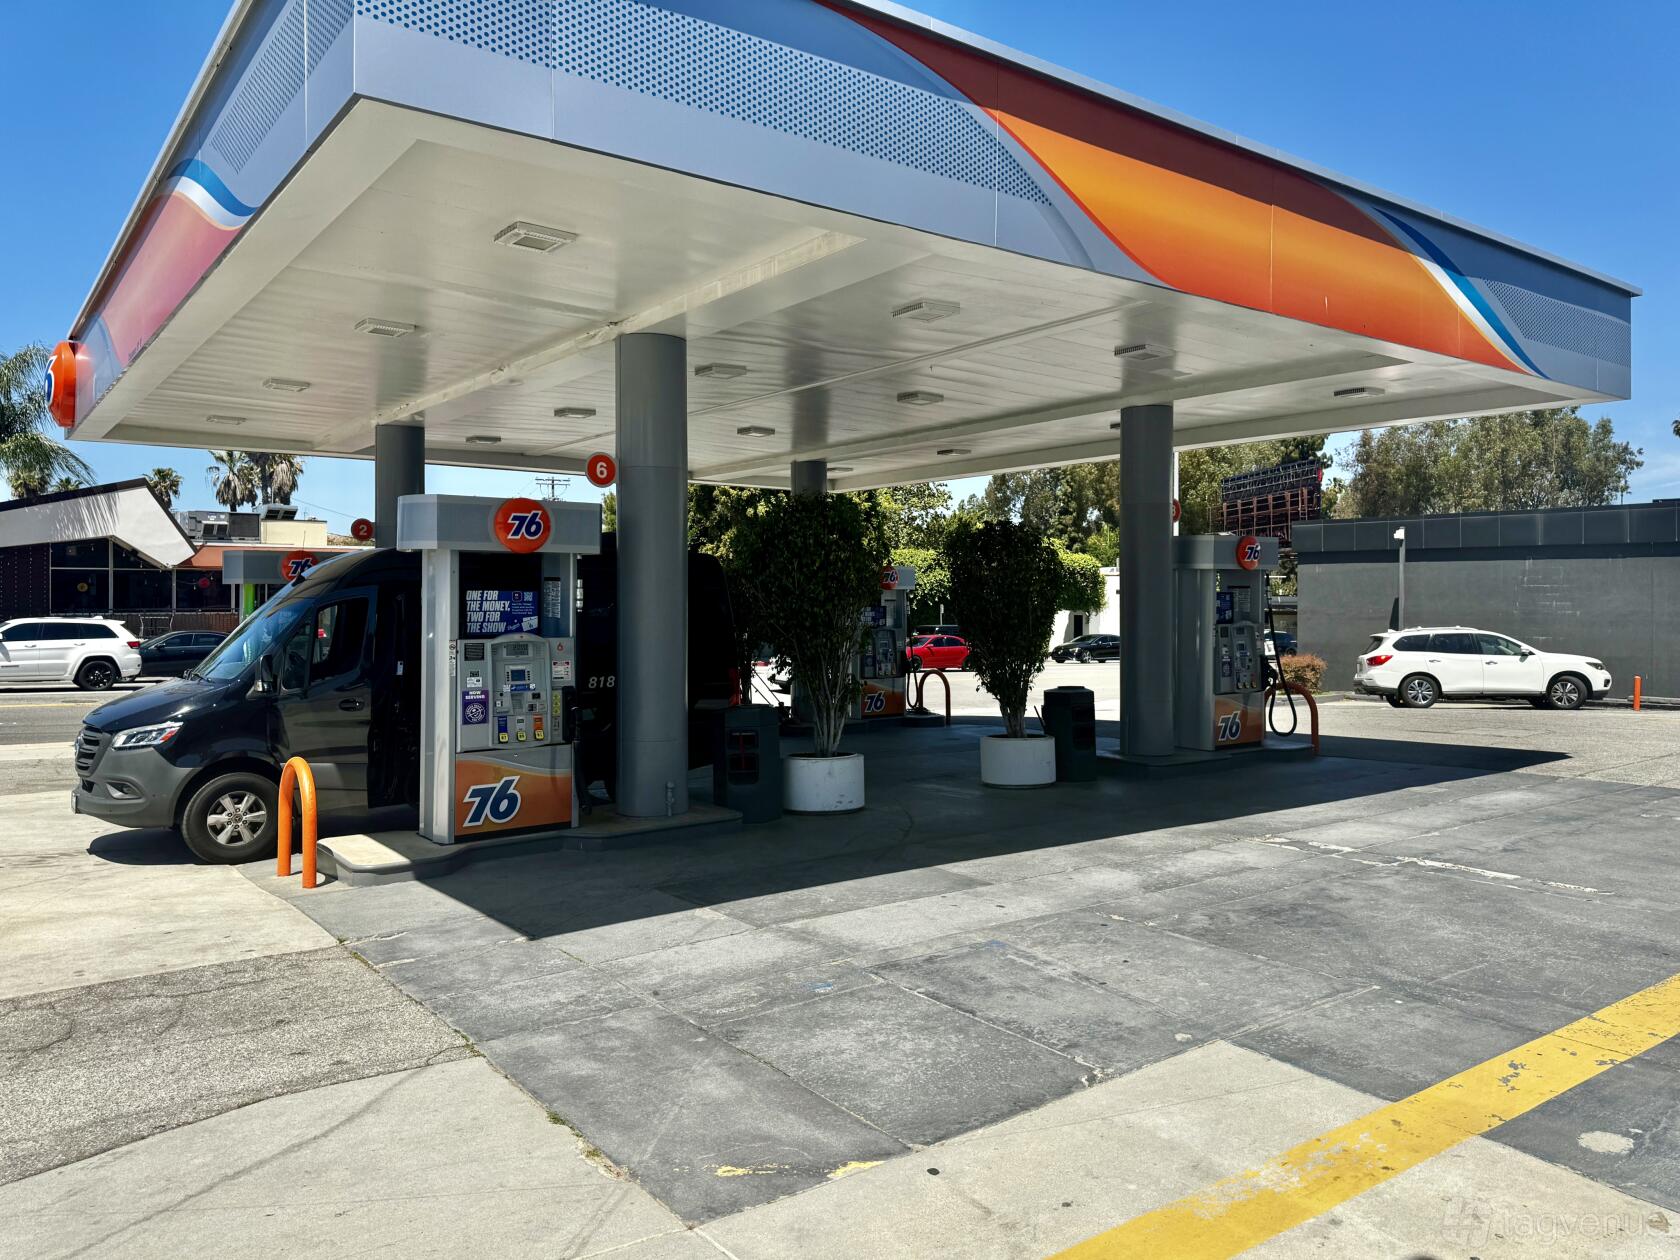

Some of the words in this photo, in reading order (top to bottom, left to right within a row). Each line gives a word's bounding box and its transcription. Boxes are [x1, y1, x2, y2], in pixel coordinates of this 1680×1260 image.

[596, 461, 608, 479] 6
[359, 525, 368, 536] 2
[507, 510, 544, 540] 76
[1245, 542, 1261, 561] 76
[883, 570, 897, 584] 76
[465, 590, 482, 601] ONE
[483, 590, 499, 601] FOR
[466, 600, 482, 612] THE
[482, 600, 511, 612] MONEY,
[466, 611, 484, 623] TWO
[485, 611, 501, 623] FOR
[466, 622, 481, 633] THE
[482, 622, 507, 633] SHOW
[588, 676, 615, 688] 818
[864, 692, 886, 713] 76
[1218, 712, 1241, 741] 76
[462, 775, 522, 828] 76
